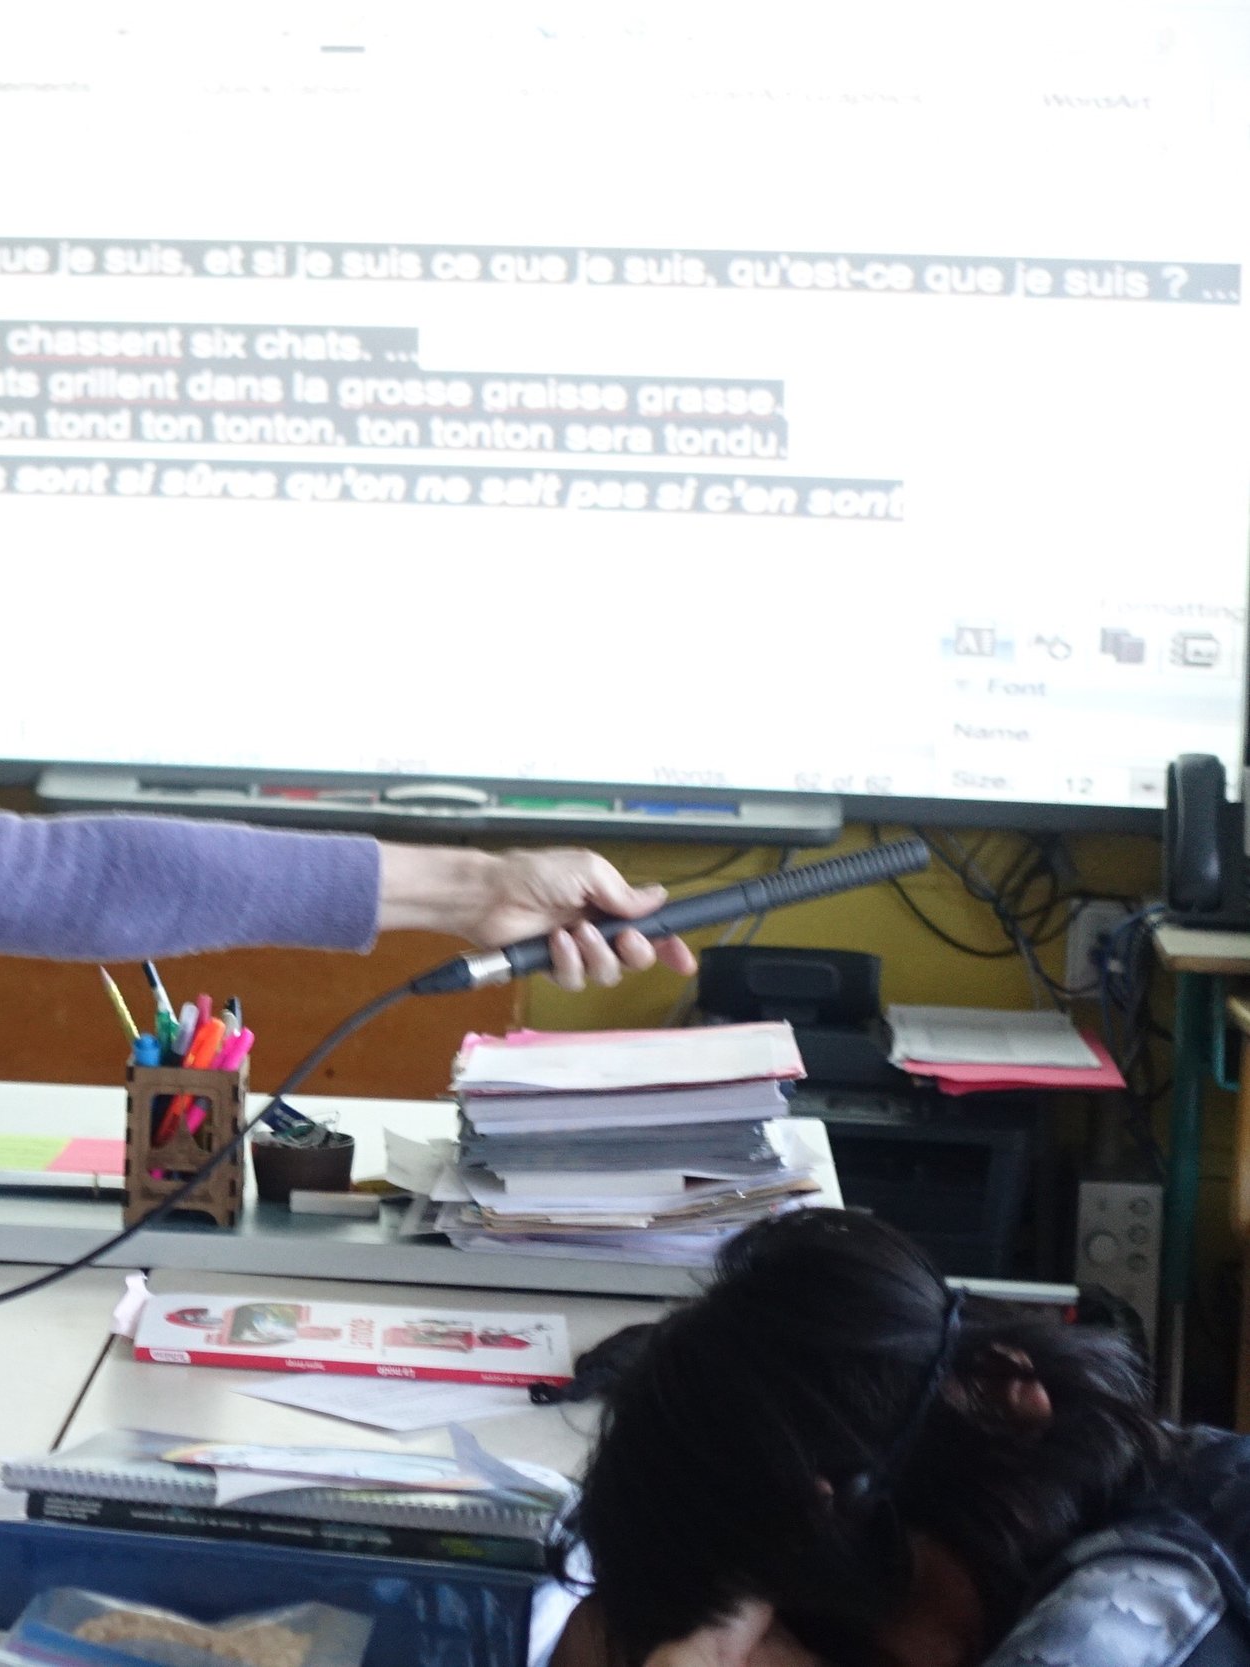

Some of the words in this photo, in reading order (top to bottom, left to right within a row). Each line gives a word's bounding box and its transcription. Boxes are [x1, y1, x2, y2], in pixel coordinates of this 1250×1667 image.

[56, 241, 95, 277] je
[103, 241, 193, 278] suis,
[203, 245, 244, 275] et
[250, 244, 286, 277] si
[295, 244, 333, 281] je
[341, 247, 422, 280] suis
[431, 252, 480, 281] ce
[489, 252, 568, 285] que
[576, 249, 615, 287] je
[623, 252, 718, 288] suis,
[923, 262, 1004, 295] que
[1012, 260, 1054, 297] je
[1062, 263, 1149, 299] suis
[1161, 265, 1190, 300] ?
[6, 325, 183, 358] chassent
[189, 328, 247, 359] six
[254, 329, 371, 361] chats.
[47, 368, 179, 402] grillent
[186, 370, 283, 402] dans
[291, 372, 329, 404] la
[338, 378, 474, 410] grosse
[482, 378, 628, 413] graisse
[637, 383, 785, 417] grasse.
[45, 407, 131, 440] tond
[140, 409, 203, 441] ton
[211, 411, 346, 447] tonton,
[357, 415, 420, 446] ton
[429, 417, 554, 450] tonton
[563, 422, 653, 452] sera
[664, 422, 787, 458] tondu.
[14, 463, 110, 494] sont
[115, 464, 157, 495] si
[286, 466, 409, 504] qu'on
[414, 477, 470, 503] ne
[479, 471, 562, 506] sait
[565, 480, 649, 511] pas
[656, 478, 697, 509] si
[703, 477, 798, 514] c'en
[986, 677, 1048, 697] Font
